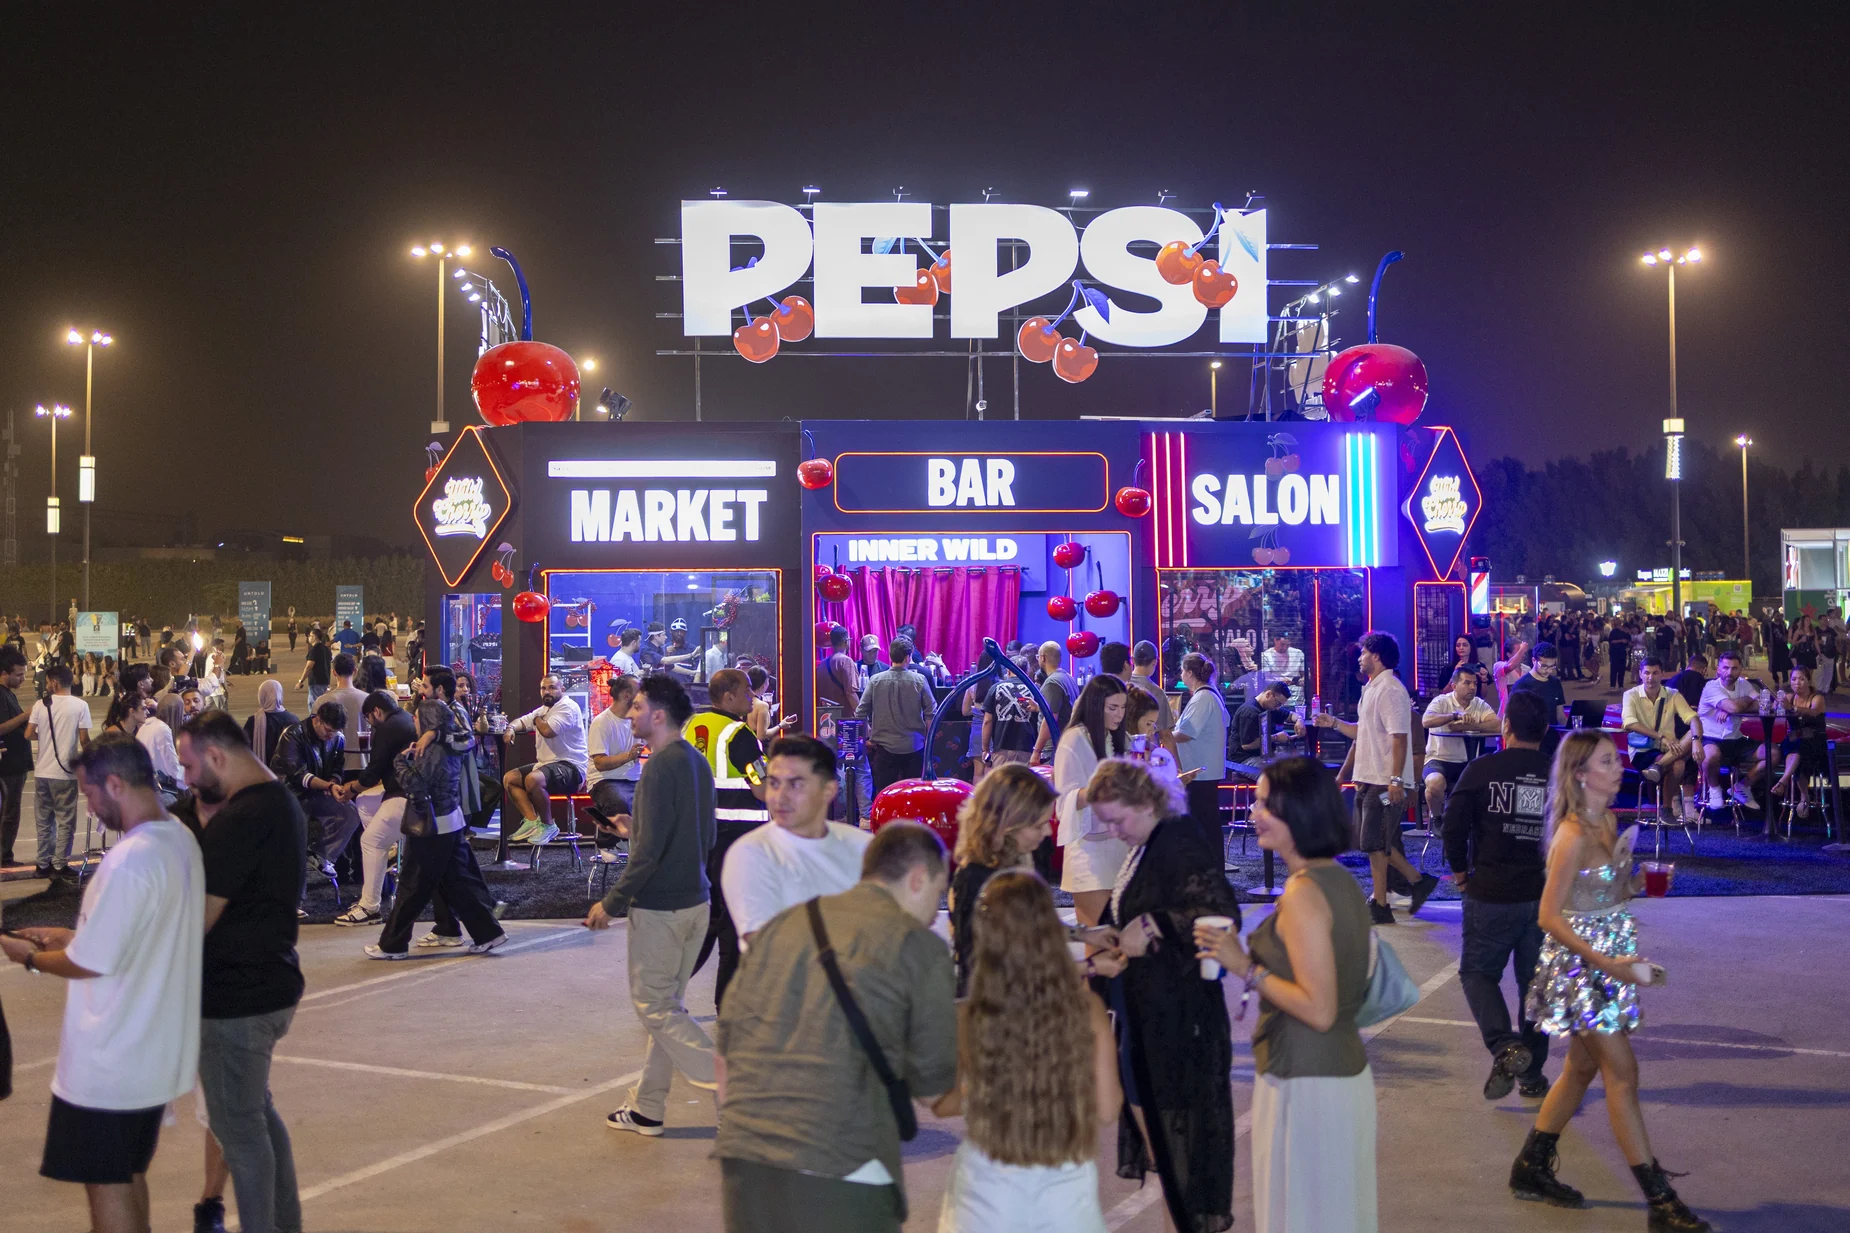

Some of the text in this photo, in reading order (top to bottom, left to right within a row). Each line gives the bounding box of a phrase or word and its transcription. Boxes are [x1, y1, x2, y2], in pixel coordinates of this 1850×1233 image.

[682, 200, 1267, 347] PEPSI
[928, 458, 1015, 506] BAR
[1191, 473, 1340, 526] SALON
[570, 490, 768, 542] MARKET
[848, 538, 1018, 561] INNER WILD
[1161, 585, 1244, 621] erry
[1502, 823, 1544, 837] NEBRAS
